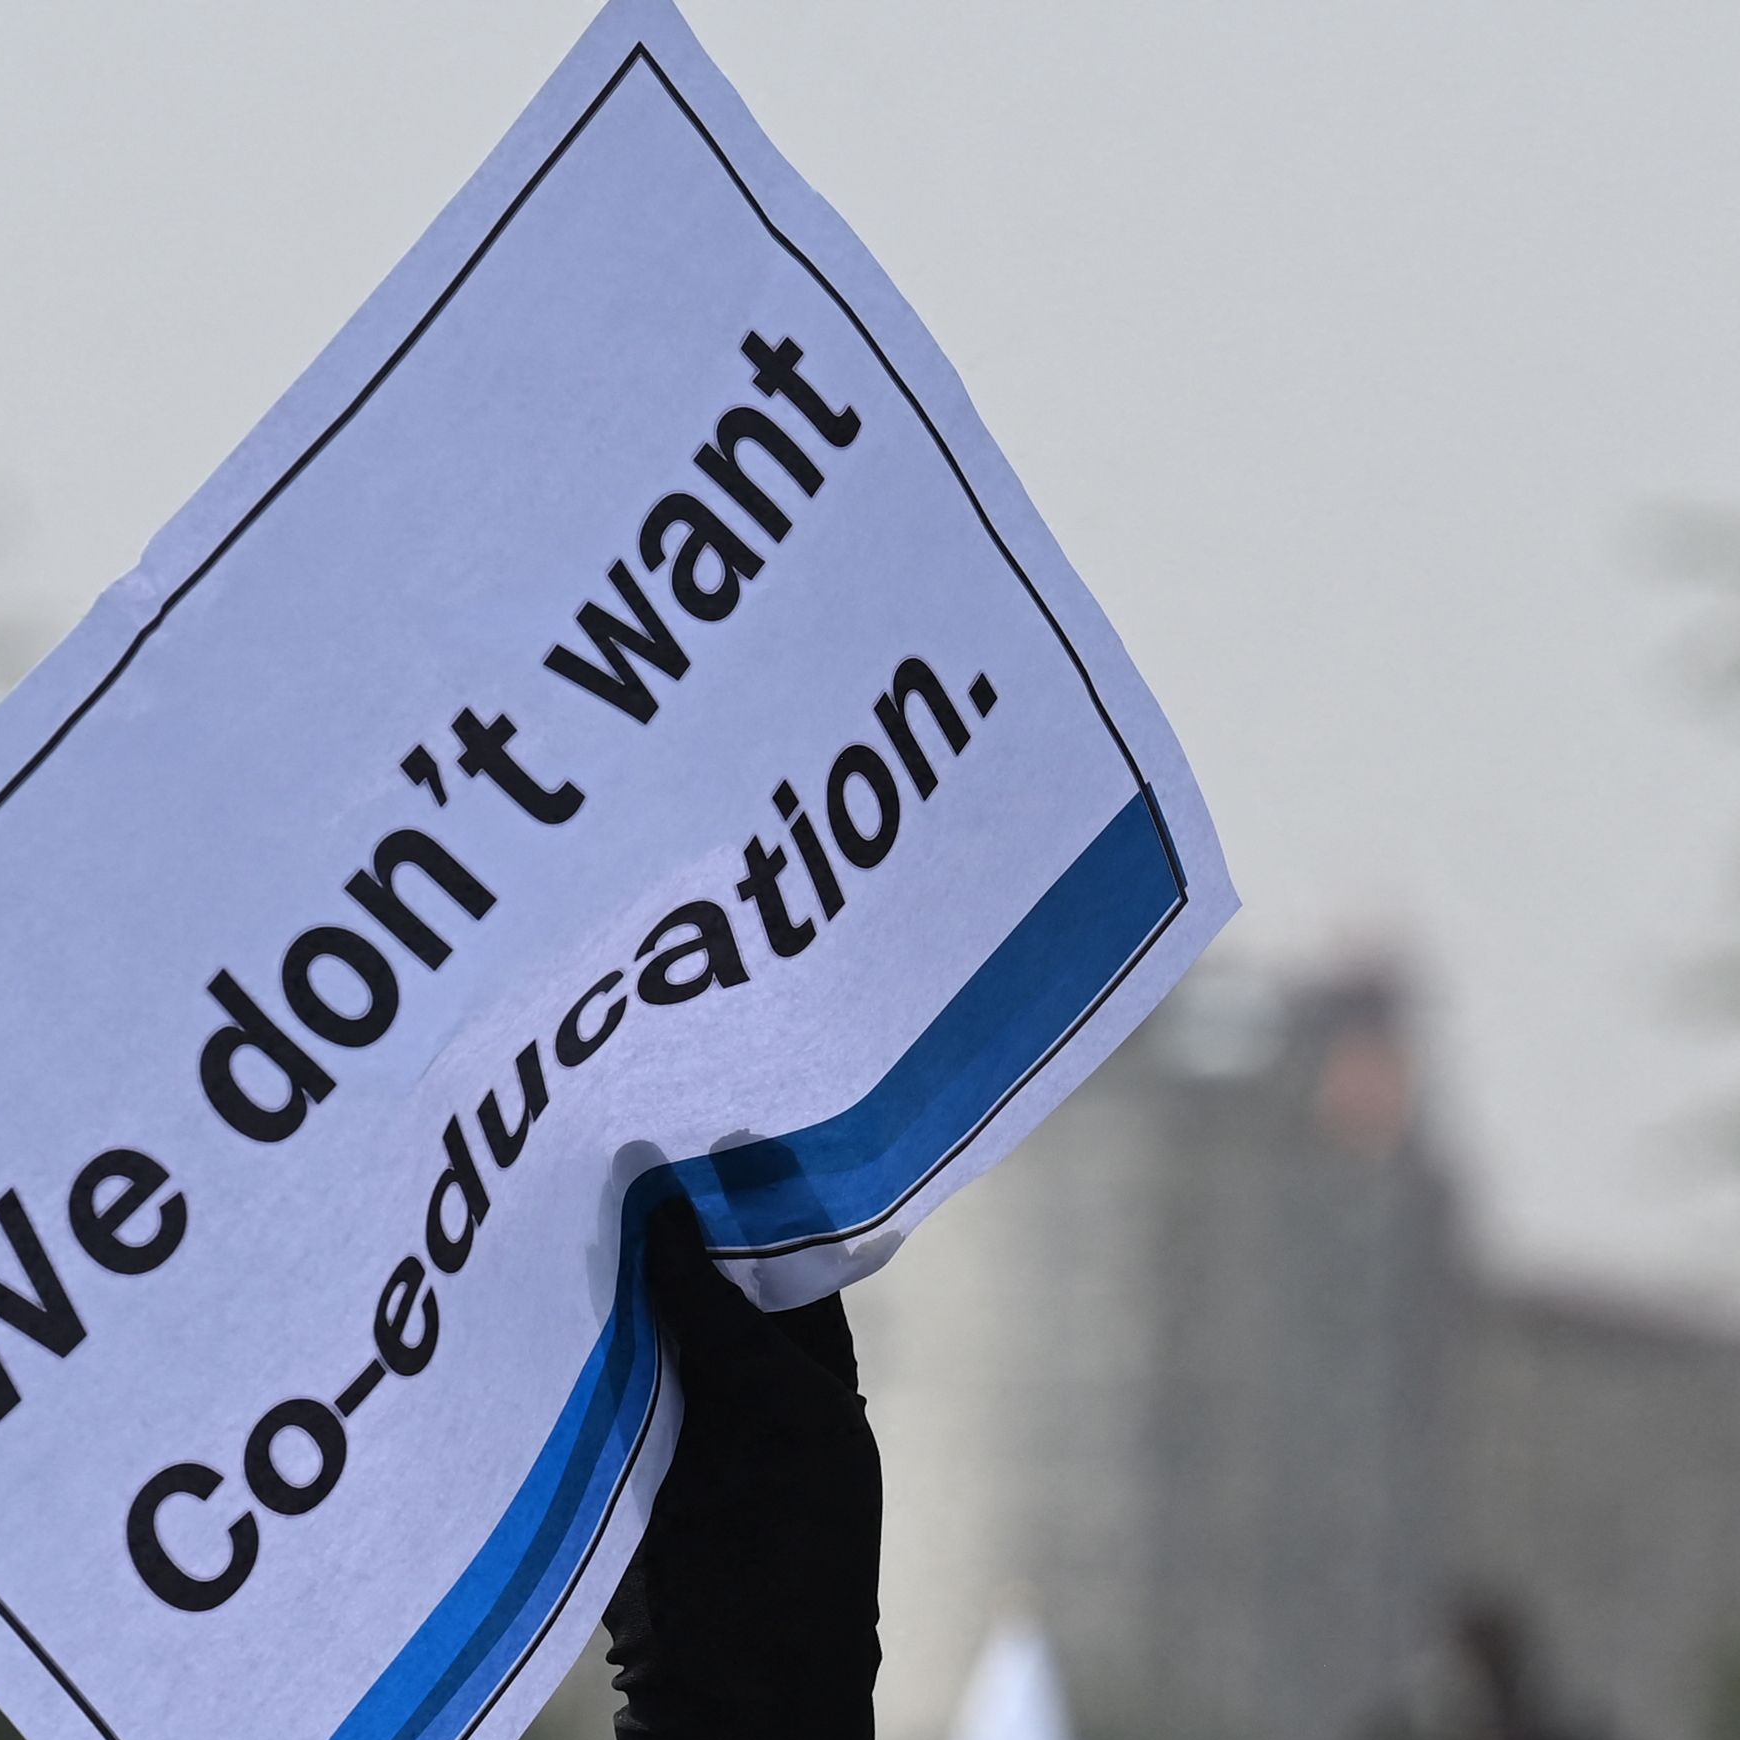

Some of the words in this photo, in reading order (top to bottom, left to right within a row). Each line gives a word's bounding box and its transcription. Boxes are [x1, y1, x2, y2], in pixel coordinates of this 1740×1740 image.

[126, 656, 999, 1613] Co-education.
[199, 707, 586, 1143] don't
[543, 330, 863, 725] want
